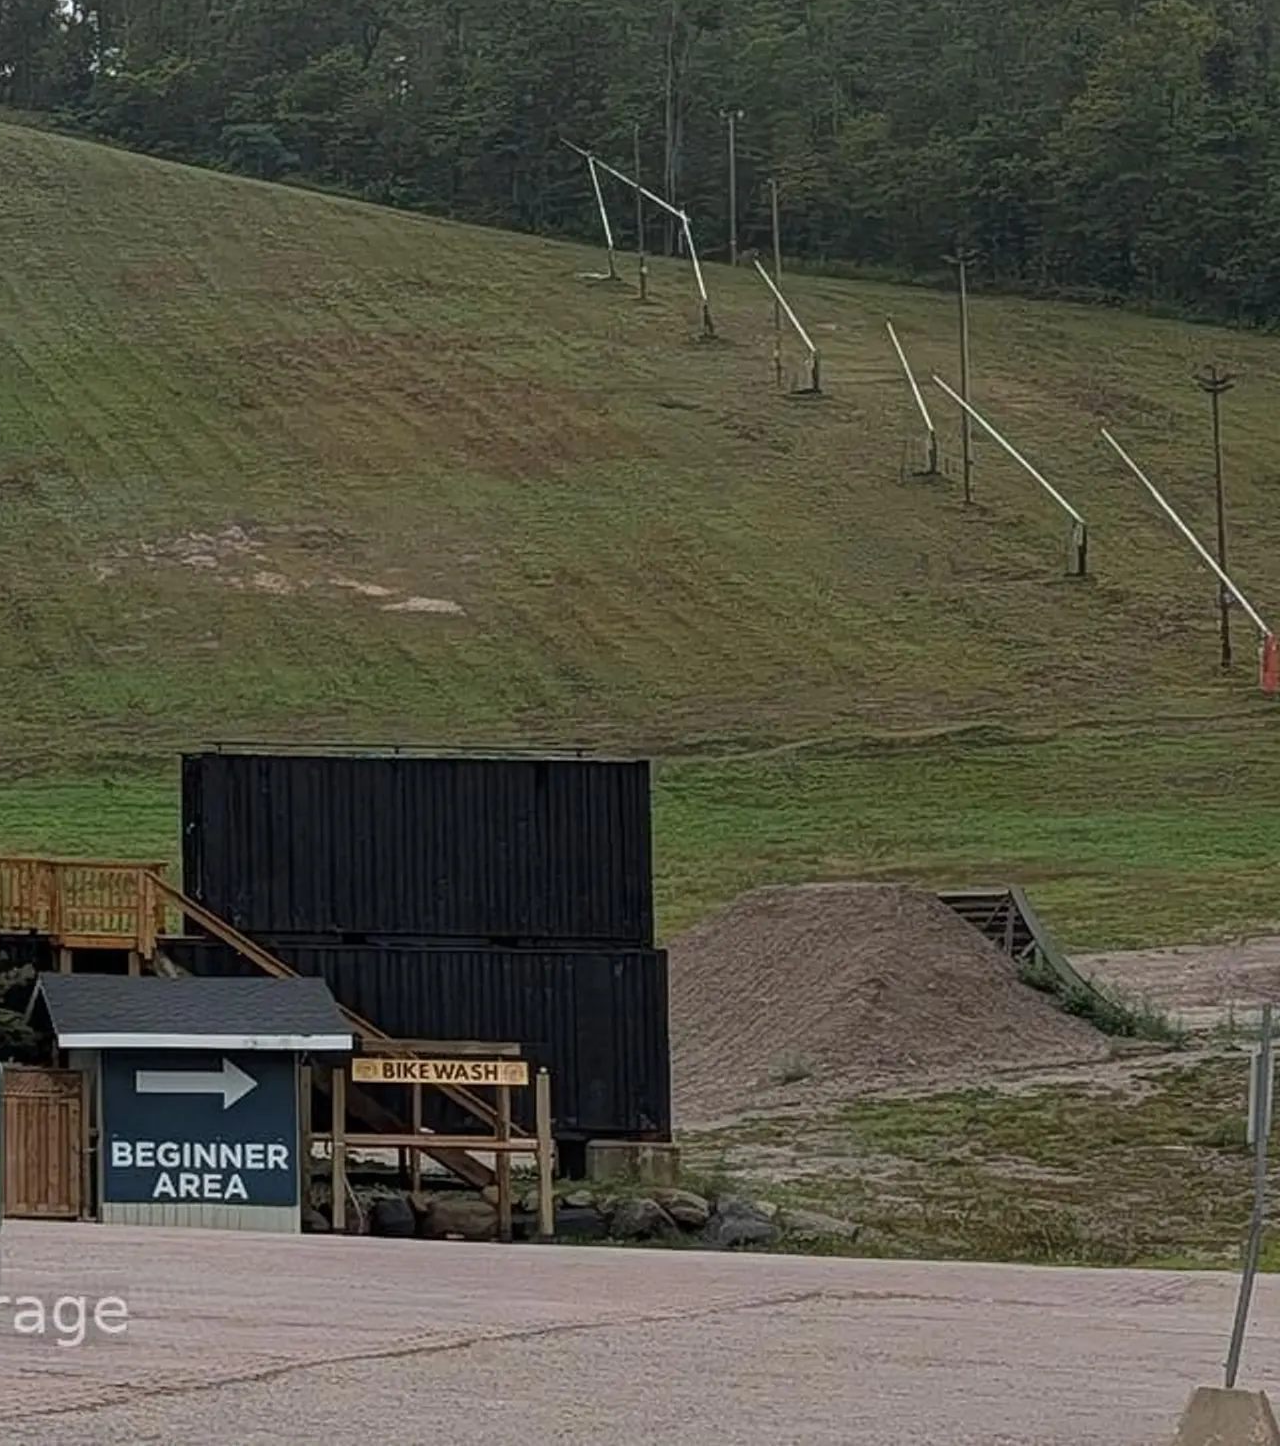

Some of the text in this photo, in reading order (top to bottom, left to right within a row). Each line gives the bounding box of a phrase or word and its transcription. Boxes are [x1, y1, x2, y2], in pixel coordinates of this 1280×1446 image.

[382, 1062, 498, 1081] BIKE WASH
[111, 1141, 289, 1170] BEGINNER
[152, 1171, 249, 1200] AREA
